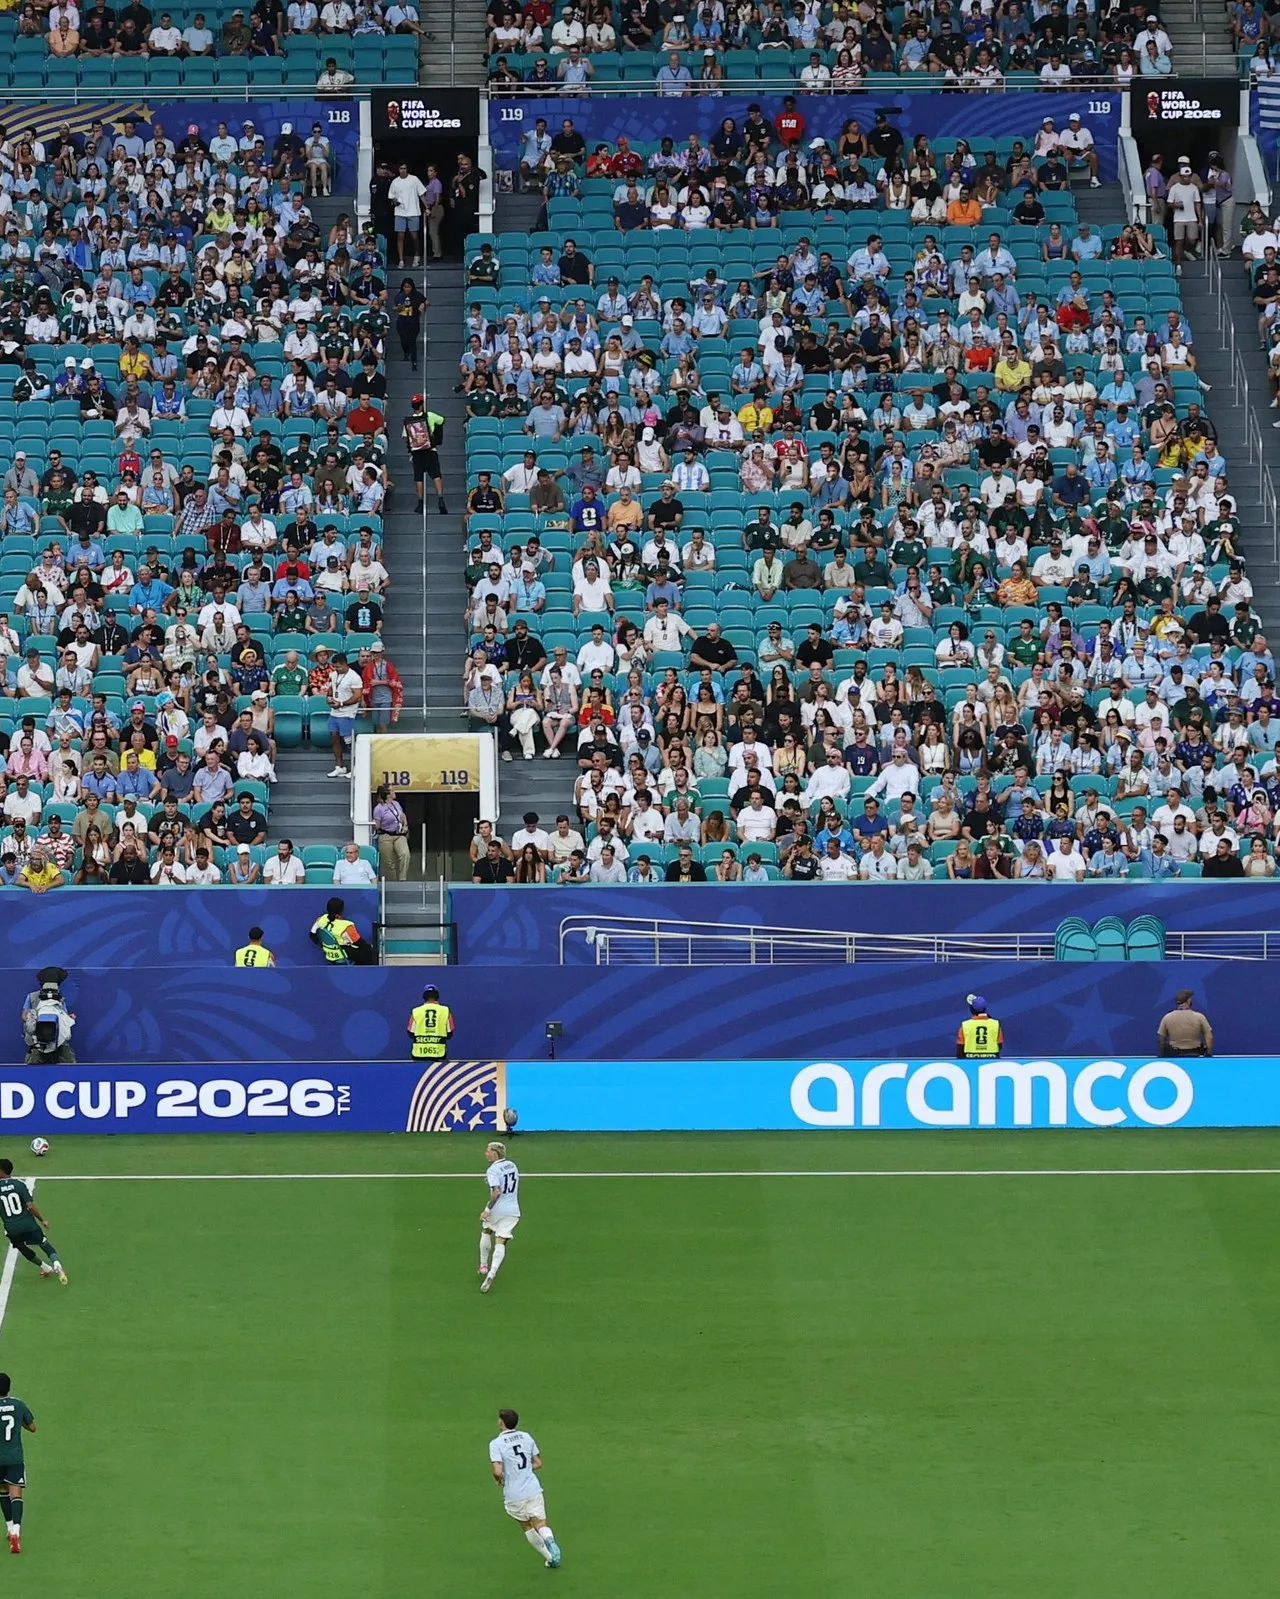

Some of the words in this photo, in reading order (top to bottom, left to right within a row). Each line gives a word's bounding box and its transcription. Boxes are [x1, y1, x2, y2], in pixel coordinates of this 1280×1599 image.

[1161, 91, 1184, 100] FIFA
[402, 100, 424, 109] FIFA
[1088, 101, 1111, 114] 119
[1161, 100, 1200, 109] WORLD
[328, 110, 350, 123] 118
[402, 109, 440, 119] WORLD
[501, 108, 524, 121] 119
[1161, 110, 1183, 119] CUP
[1184, 109, 1222, 119] 2026
[402, 119, 423, 128] CUP
[424, 119, 461, 128] 2026
[382, 771, 410, 786] 118
[440, 770, 468, 785] 119
[45, 1081, 147, 1119] CUP
[156, 1079, 336, 1118] 2026
[337, 1085, 351, 1116] TM
[790, 1061, 1194, 1126] aramco
[502, 1171, 517, 1194] 13
[0, 1192, 23, 1217] 10
[1, 1415, 15, 1441] 7
[512, 1444, 527, 1470] 5
